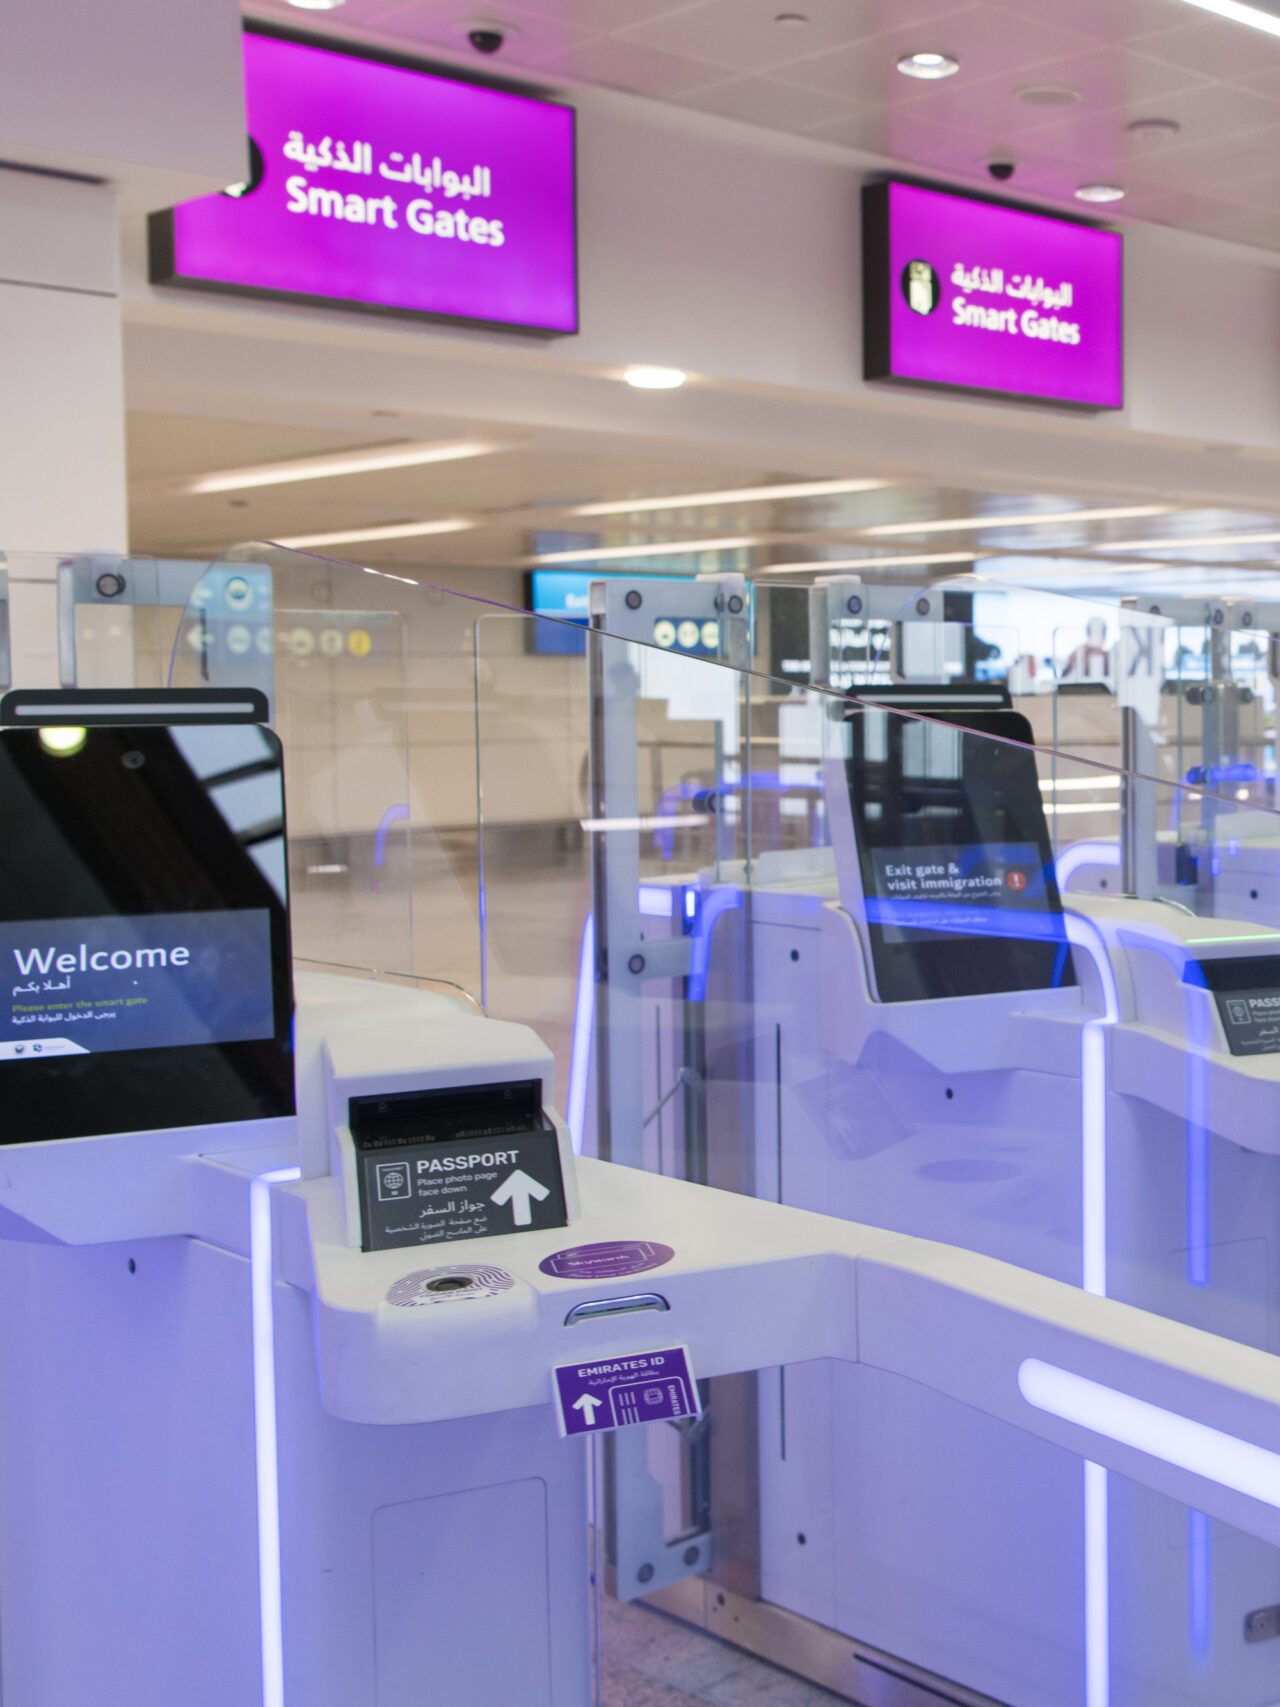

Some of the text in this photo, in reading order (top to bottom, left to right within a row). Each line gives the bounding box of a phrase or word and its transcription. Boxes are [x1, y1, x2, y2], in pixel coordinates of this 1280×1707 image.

[283, 130, 491, 201] البوابات الذكية
[286, 175, 505, 246] Smart Gates
[951, 263, 1072, 310] البوابات الذكية
[952, 296, 1080, 345] Smart Gates
[885, 862, 959, 878] Exit gate &
[887, 876, 1002, 891] visit immigration
[13, 943, 190, 976] Welcome
[12, 997, 148, 1013] Please enter the smart gate
[417, 1150, 520, 1174] PASSPORT
[417, 1171, 498, 1187] Place photo page
[418, 1185, 468, 1197] face down
[419, 1200, 486, 1218] جواز السفر
[577, 1356, 665, 1378] EMIRATES ID
[667, 1384, 682, 1416] EMIRATES
